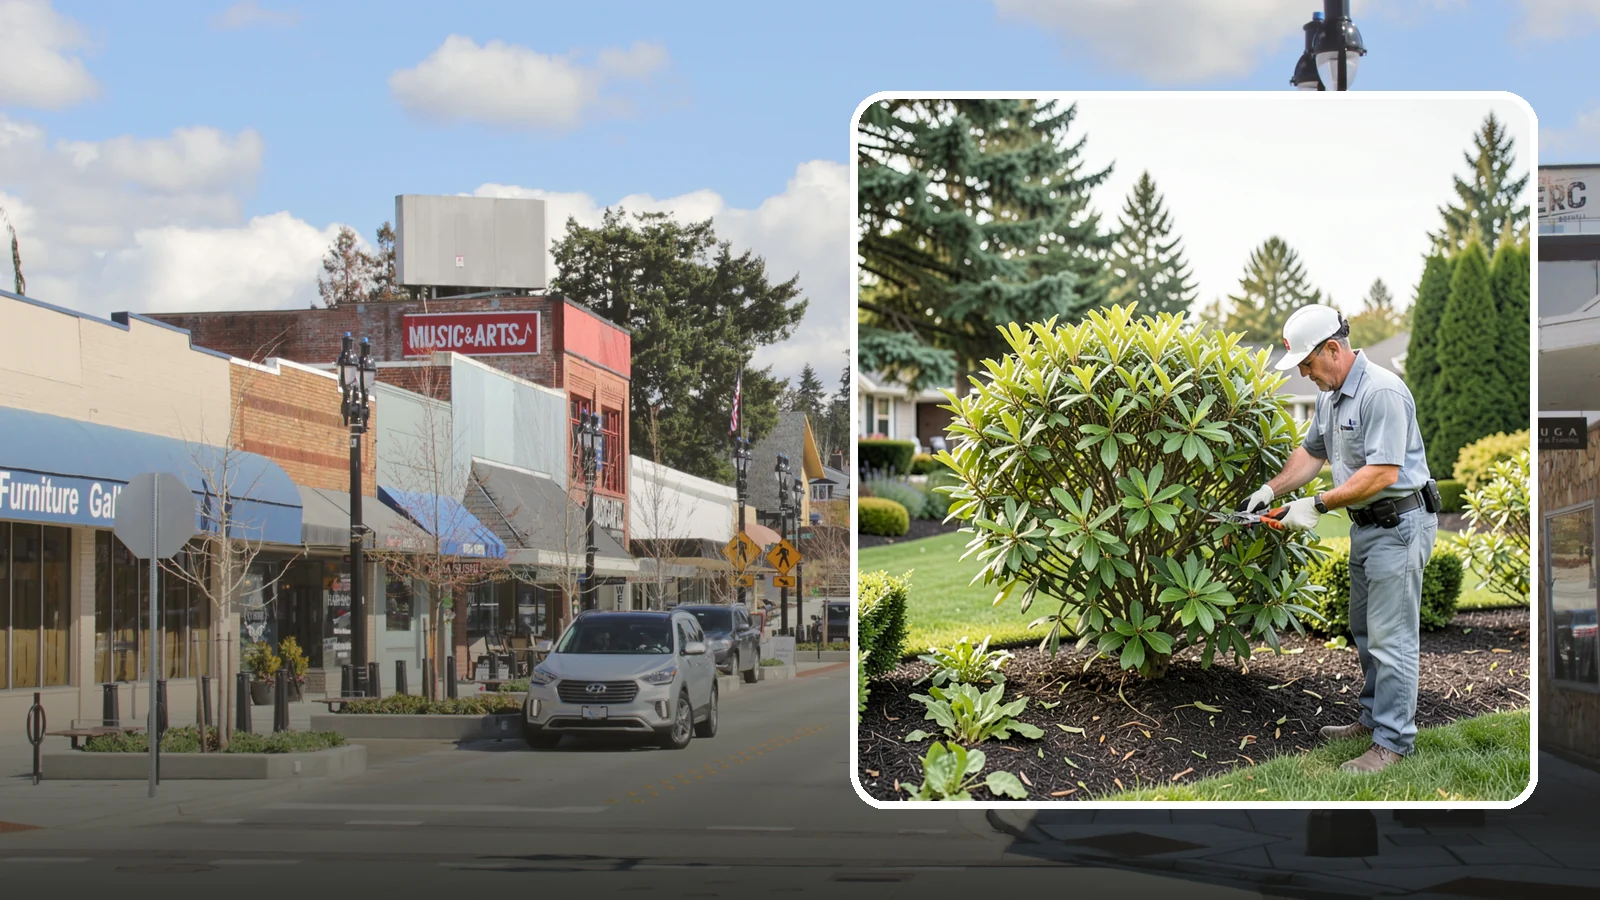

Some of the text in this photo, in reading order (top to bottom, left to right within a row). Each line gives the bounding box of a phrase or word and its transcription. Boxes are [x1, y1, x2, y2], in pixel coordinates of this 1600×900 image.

[409, 323, 519, 348] MUSIC&ARTS
[1540, 428, 1577, 436] UGA
[0, 472, 122, 519] Furniture Gal
